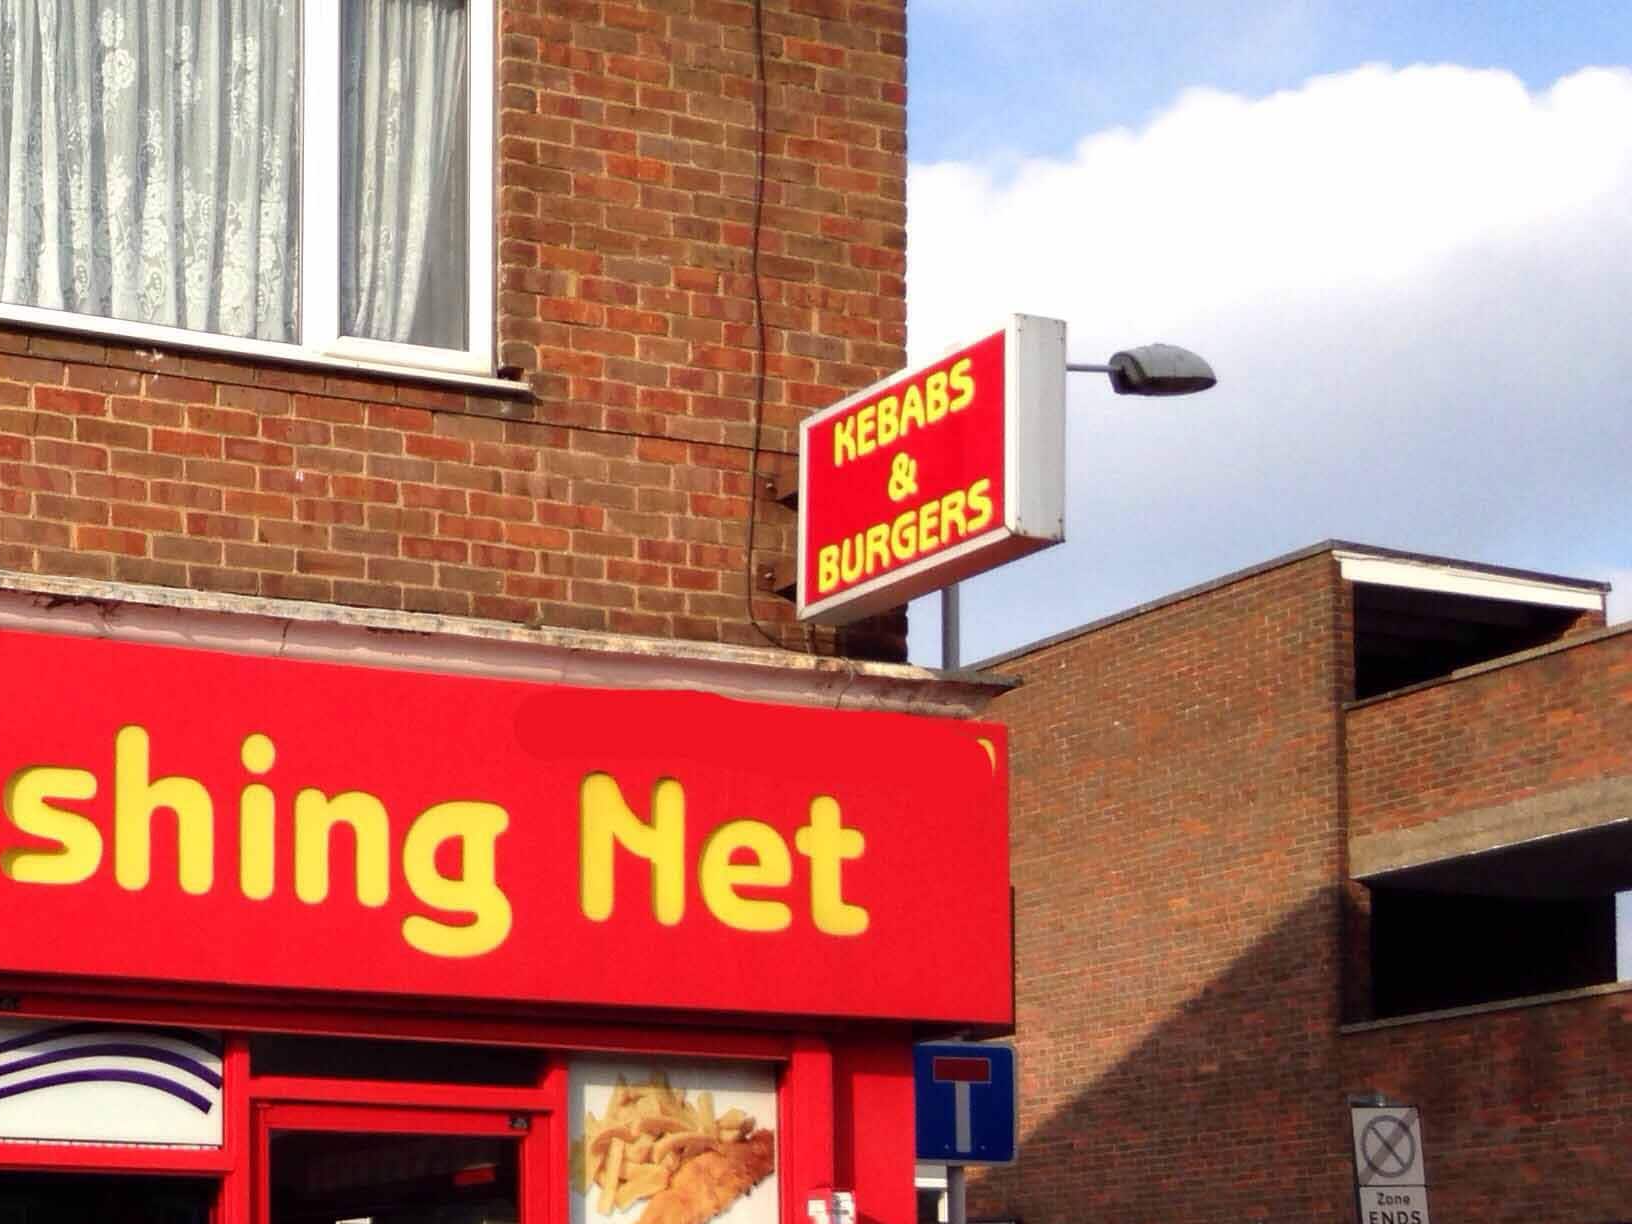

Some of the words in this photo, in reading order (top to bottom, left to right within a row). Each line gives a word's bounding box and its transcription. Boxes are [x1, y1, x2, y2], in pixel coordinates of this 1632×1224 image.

[833, 358, 975, 468] KEBABS
[887, 452, 918, 502] &
[818, 478, 993, 593] BURGERS
[580, 770, 870, 937] Net
[1376, 1192, 1411, 1206] Zone
